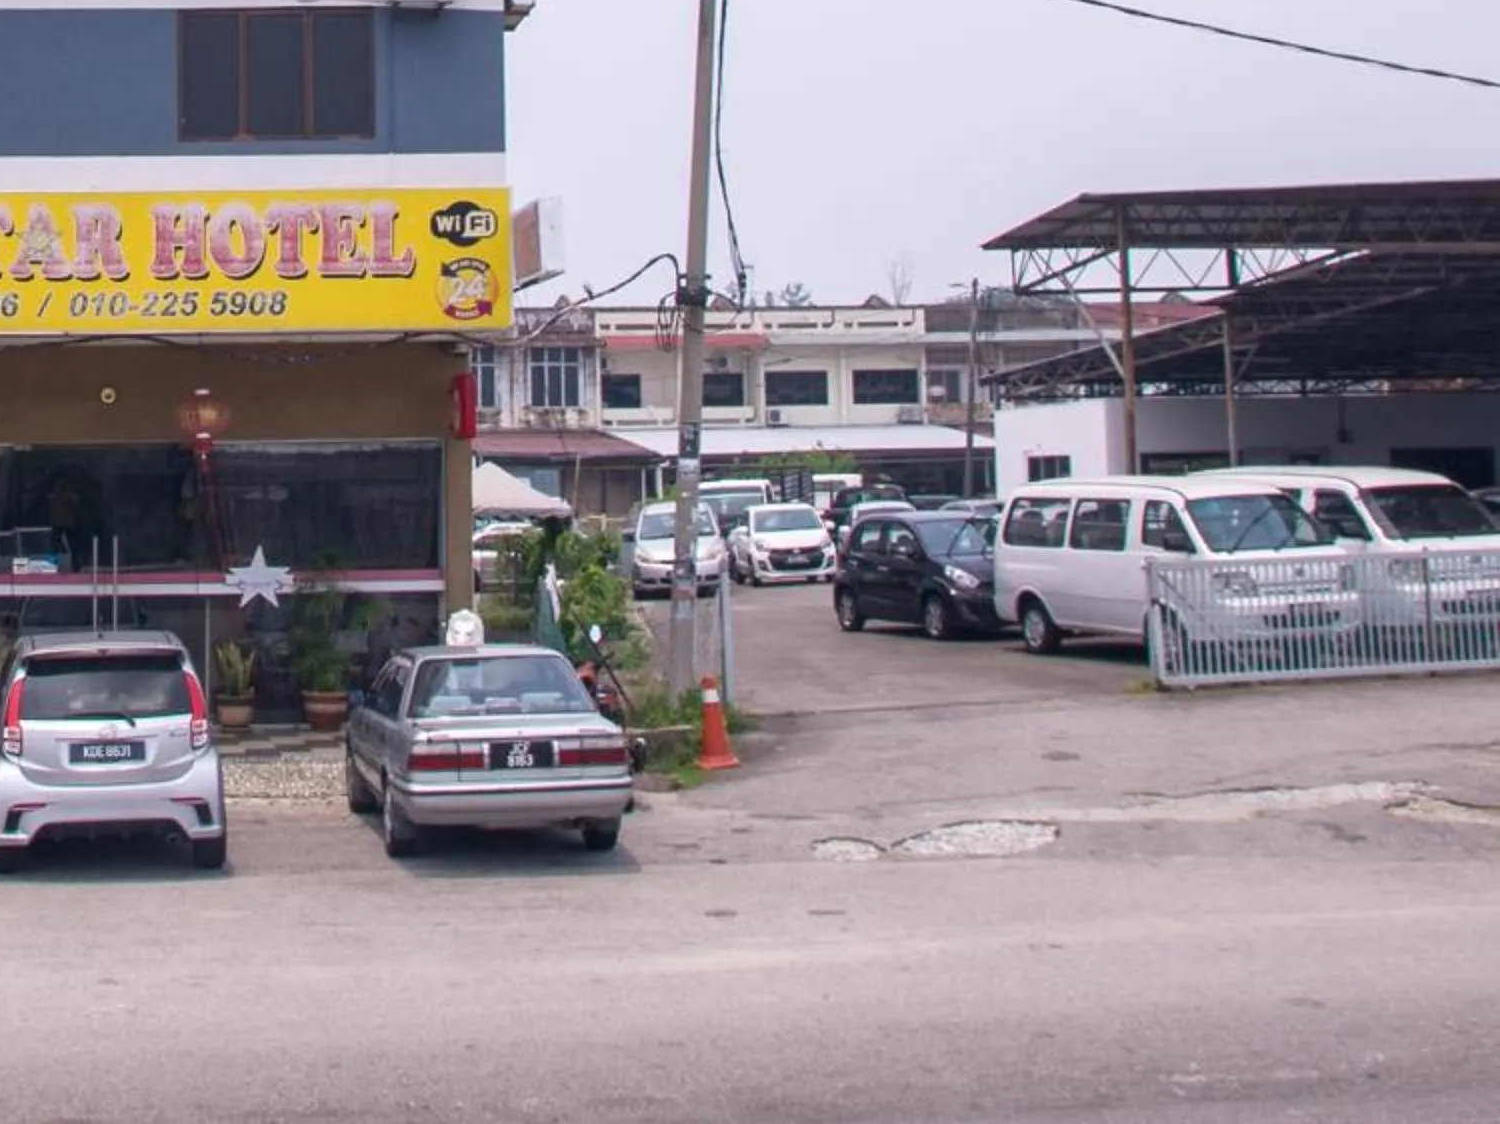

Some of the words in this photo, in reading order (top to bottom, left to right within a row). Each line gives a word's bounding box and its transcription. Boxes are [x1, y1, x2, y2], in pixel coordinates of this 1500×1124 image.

[148, 199, 417, 280] HOTEL
[36, 292, 52, 317] /
[69, 291, 200, 318] 010-225
[209, 291, 289, 317] 5908
